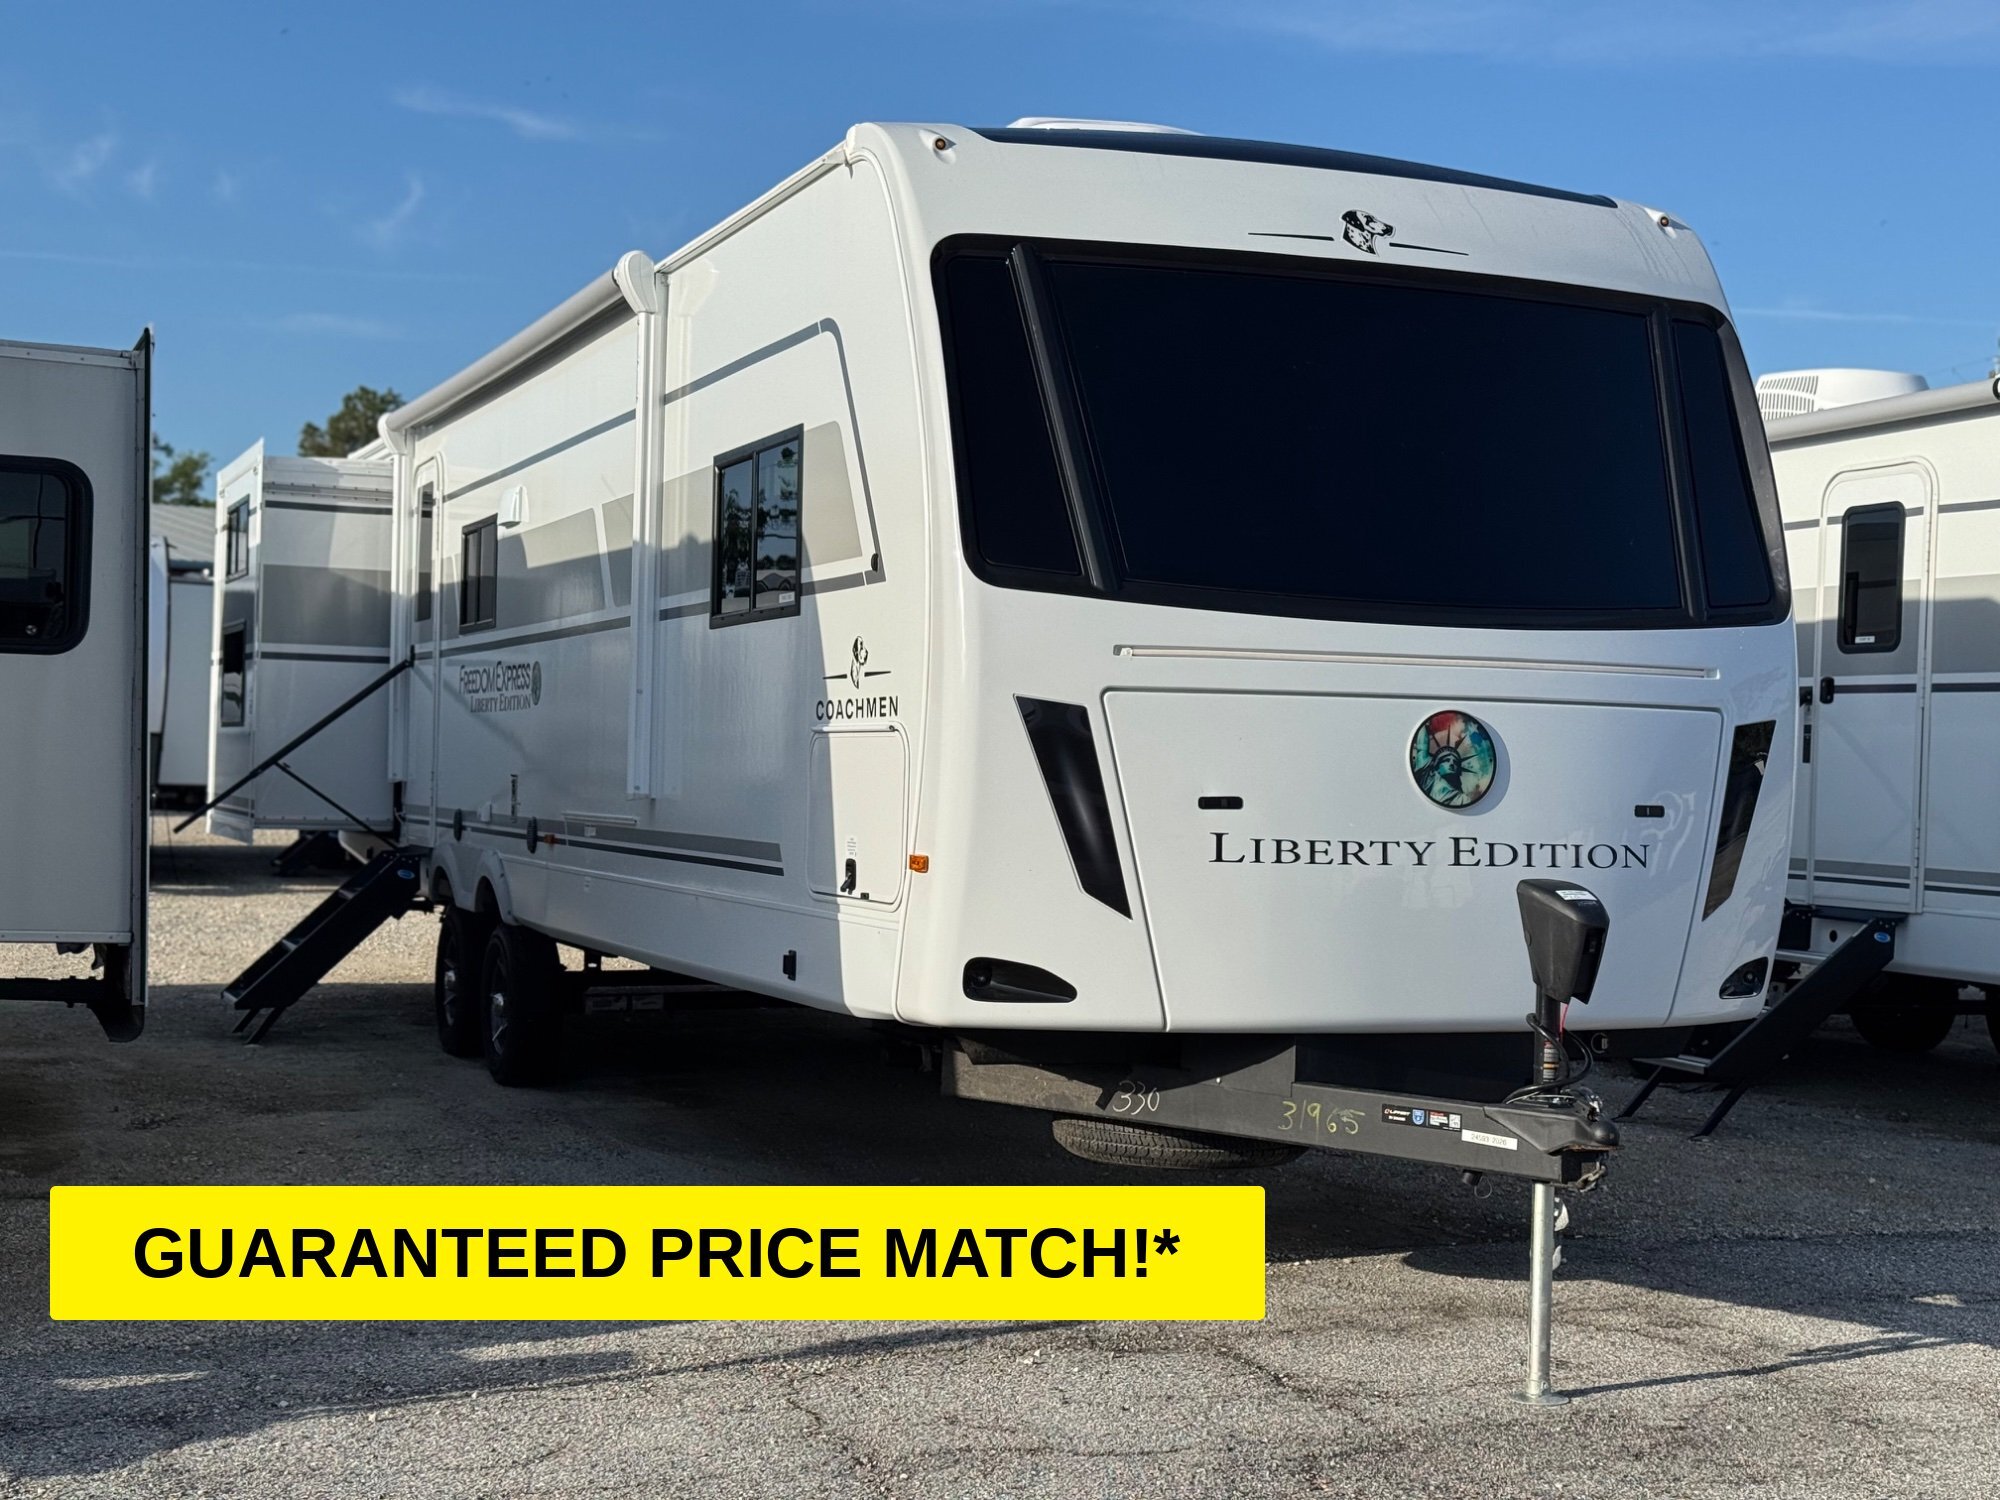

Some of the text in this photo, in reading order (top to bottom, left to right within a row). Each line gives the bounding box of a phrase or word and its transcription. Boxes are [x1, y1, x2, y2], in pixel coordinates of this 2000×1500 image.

[470, 693, 531, 713] LIBERTY EDITION
[816, 695, 899, 721] COACHMEN
[1208, 831, 1651, 870] LIBERTY EDITION
[1112, 1079, 1160, 1115] 330
